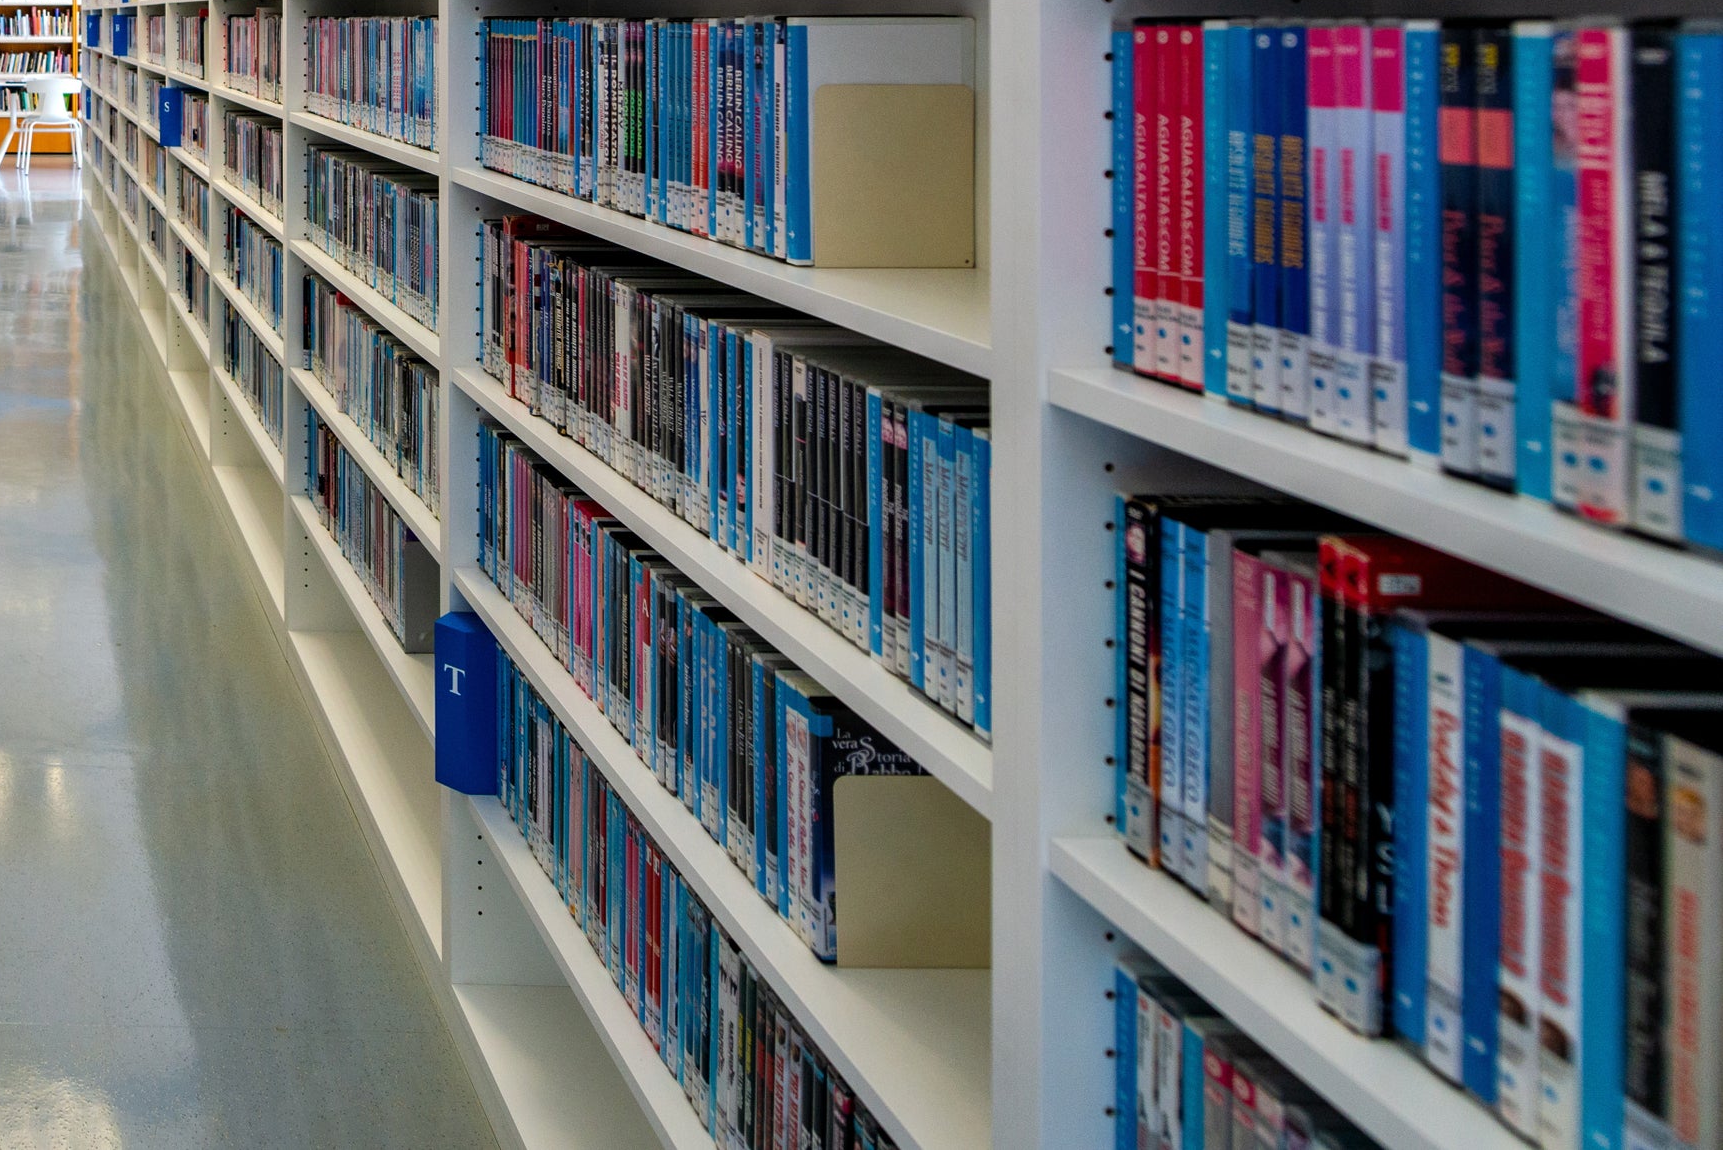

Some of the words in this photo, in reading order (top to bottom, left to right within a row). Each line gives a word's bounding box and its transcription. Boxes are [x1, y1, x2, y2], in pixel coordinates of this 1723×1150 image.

[164, 101, 170, 112] S
[444, 663, 466, 696] T
[837, 727, 850, 739] La
[832, 739, 858, 749] vera
[834, 762, 845, 773] di
